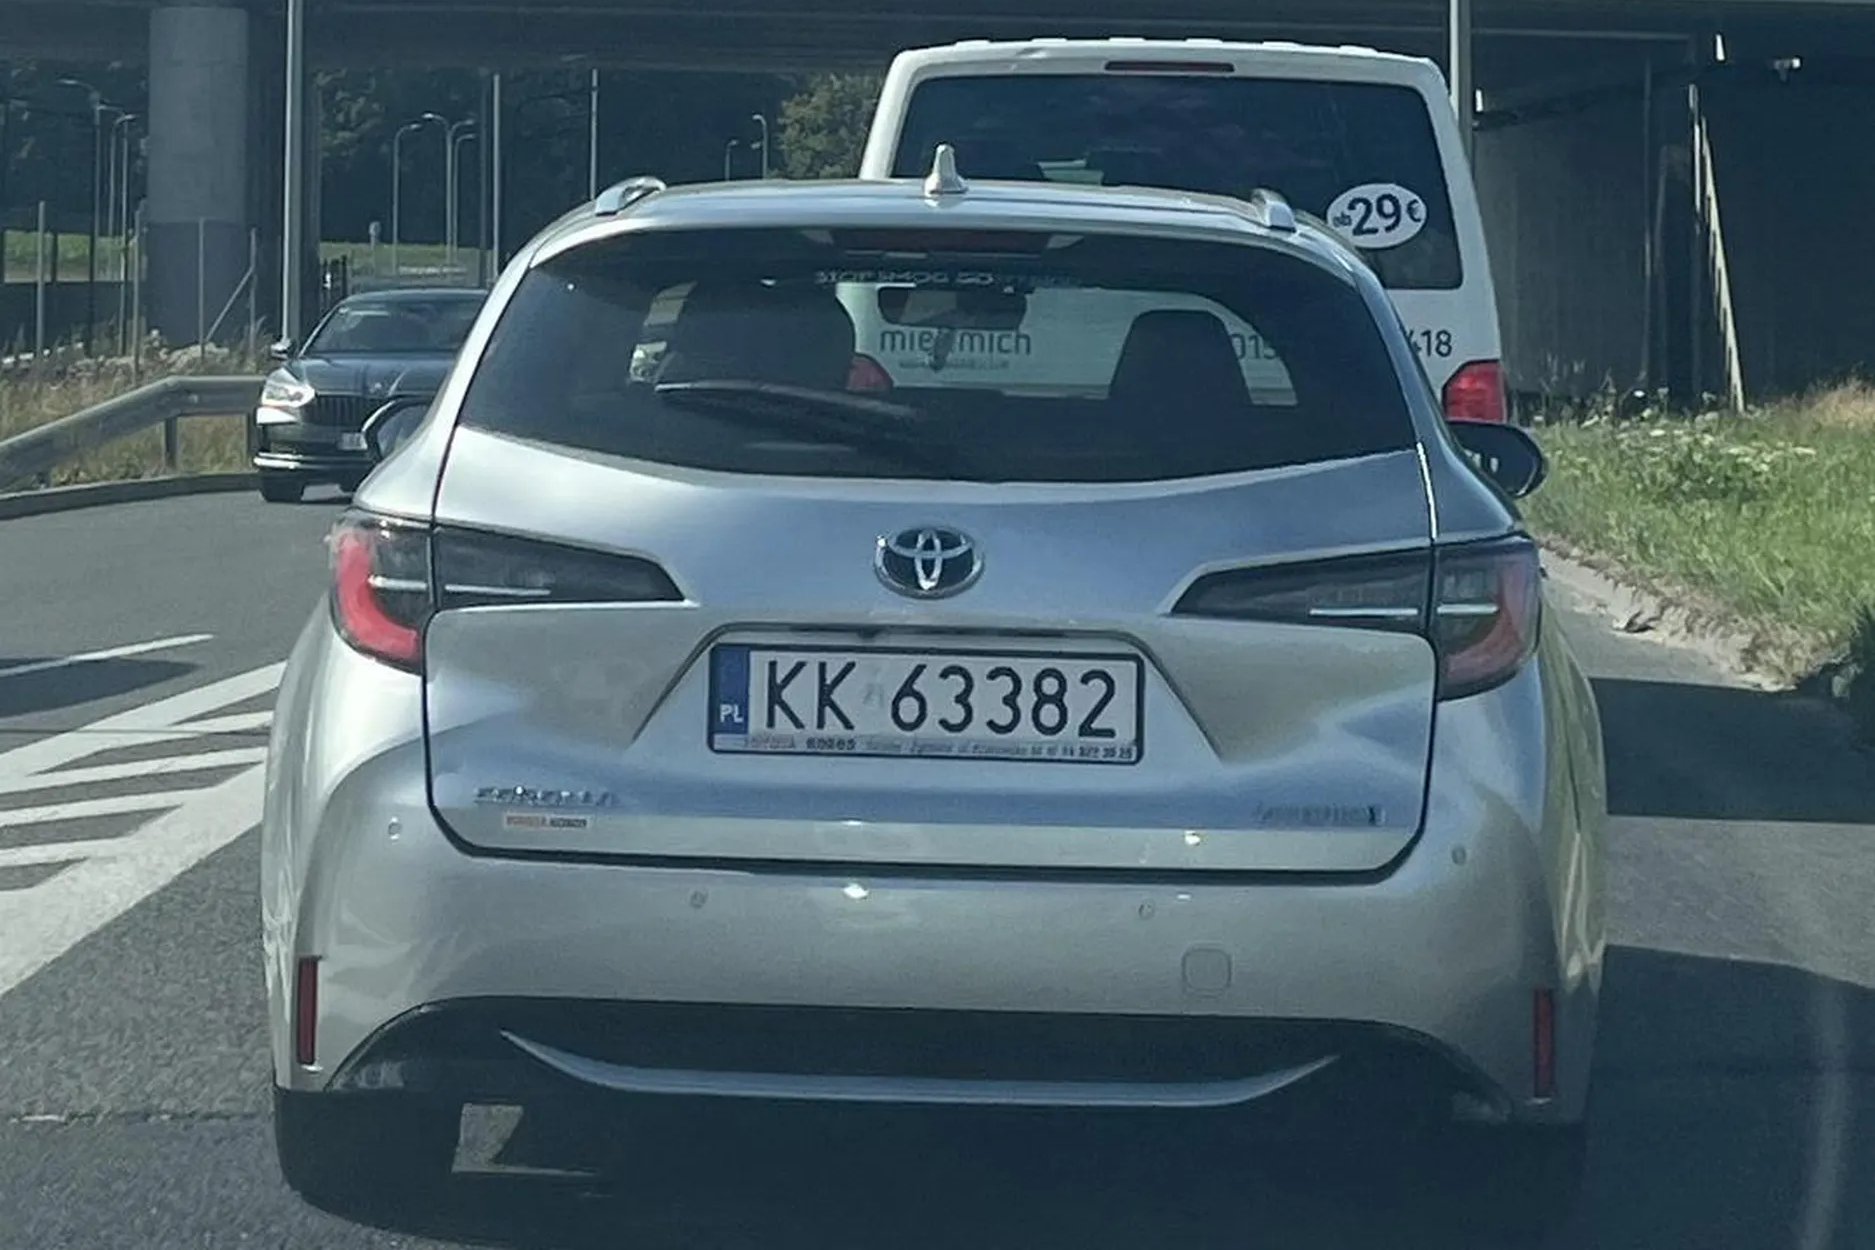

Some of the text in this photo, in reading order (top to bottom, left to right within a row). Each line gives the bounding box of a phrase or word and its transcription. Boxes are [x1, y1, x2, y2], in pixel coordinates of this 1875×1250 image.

[880, 330, 1032, 356] mie mich
[765, 660, 1117, 738] KK 63382
[719, 704, 744, 723] PL
